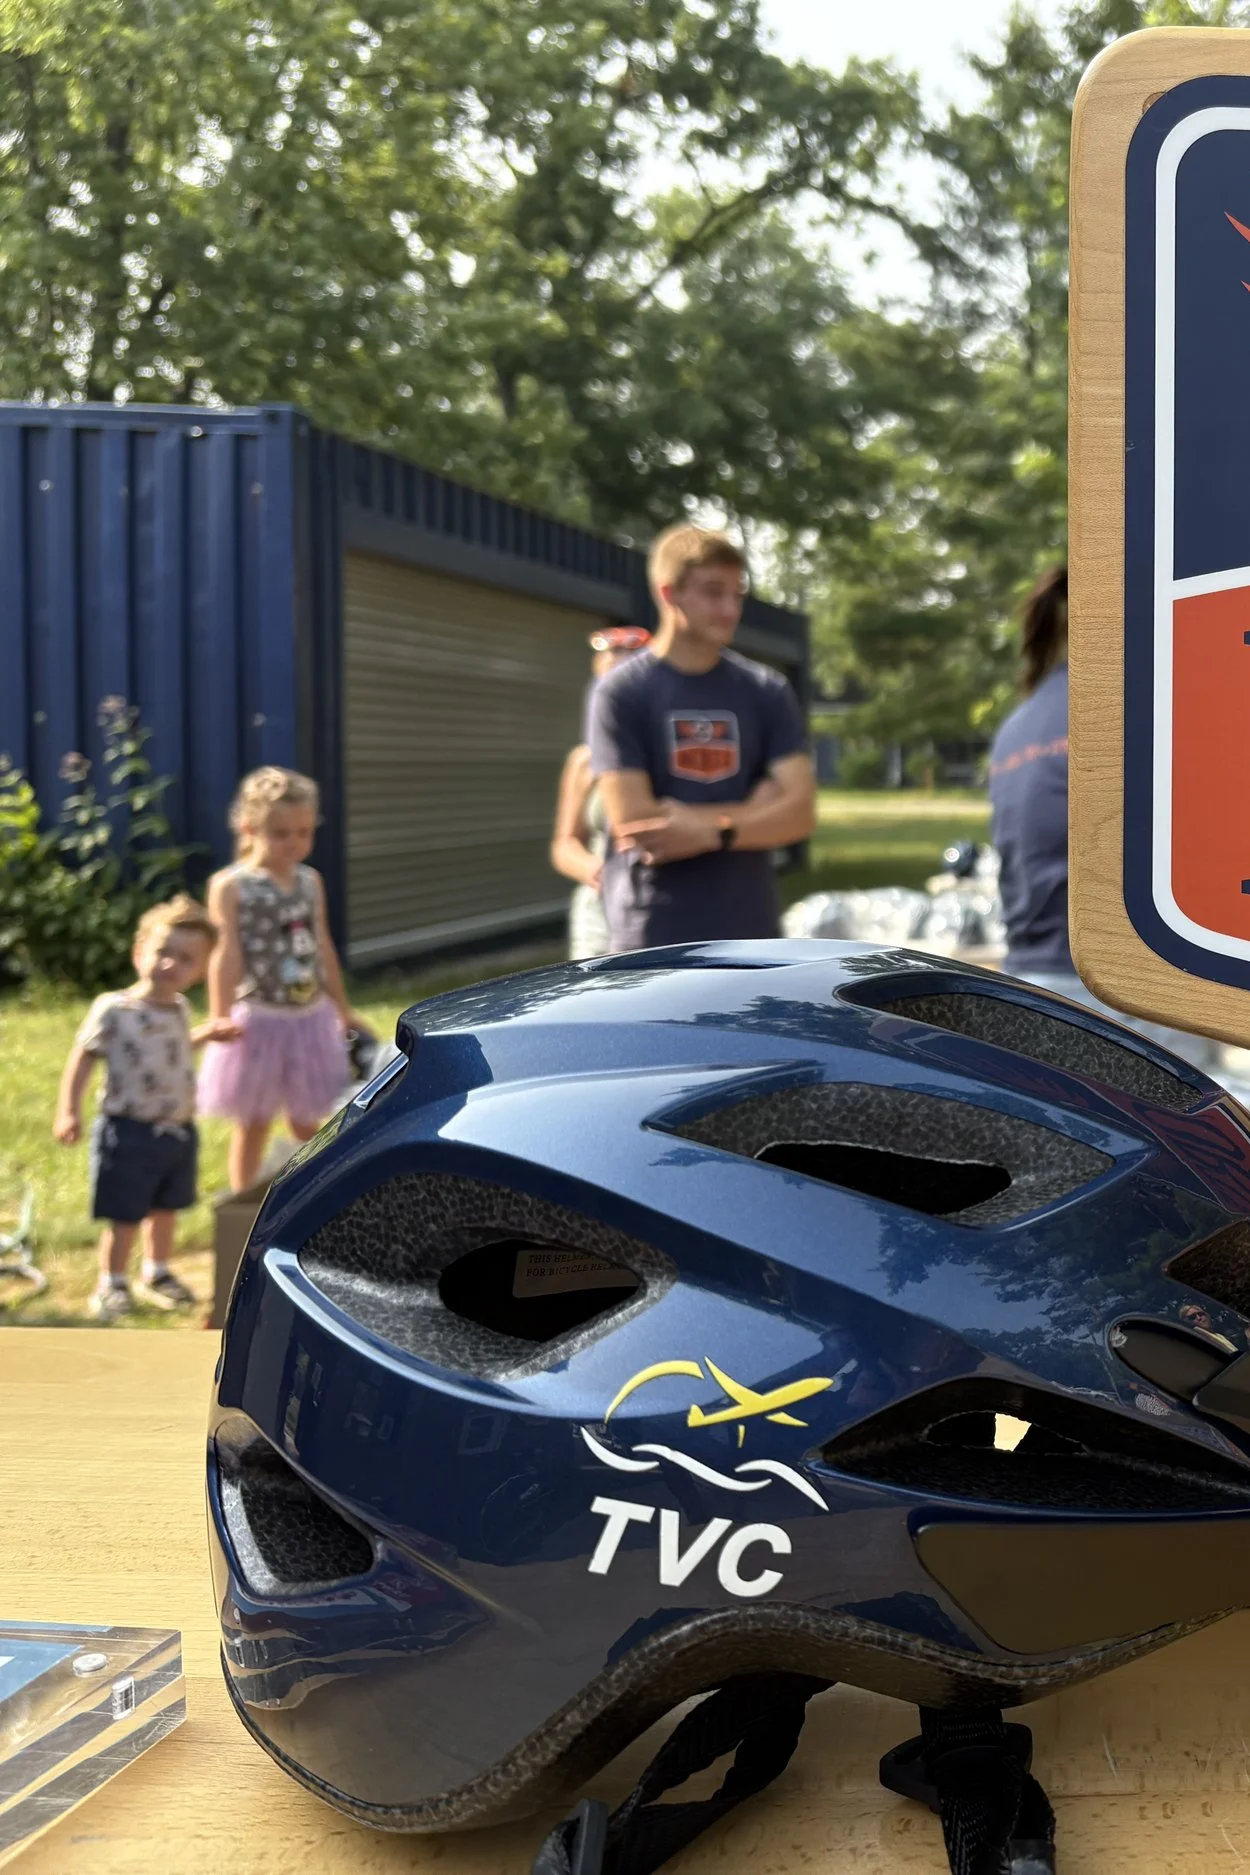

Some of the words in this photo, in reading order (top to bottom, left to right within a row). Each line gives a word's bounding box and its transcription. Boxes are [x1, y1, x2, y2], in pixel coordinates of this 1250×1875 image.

[528, 1254, 552, 1264] THIS
[526, 1267, 546, 1277] FOR
[549, 1263, 589, 1276] BICYCLE
[588, 1496, 792, 1598] TVC
